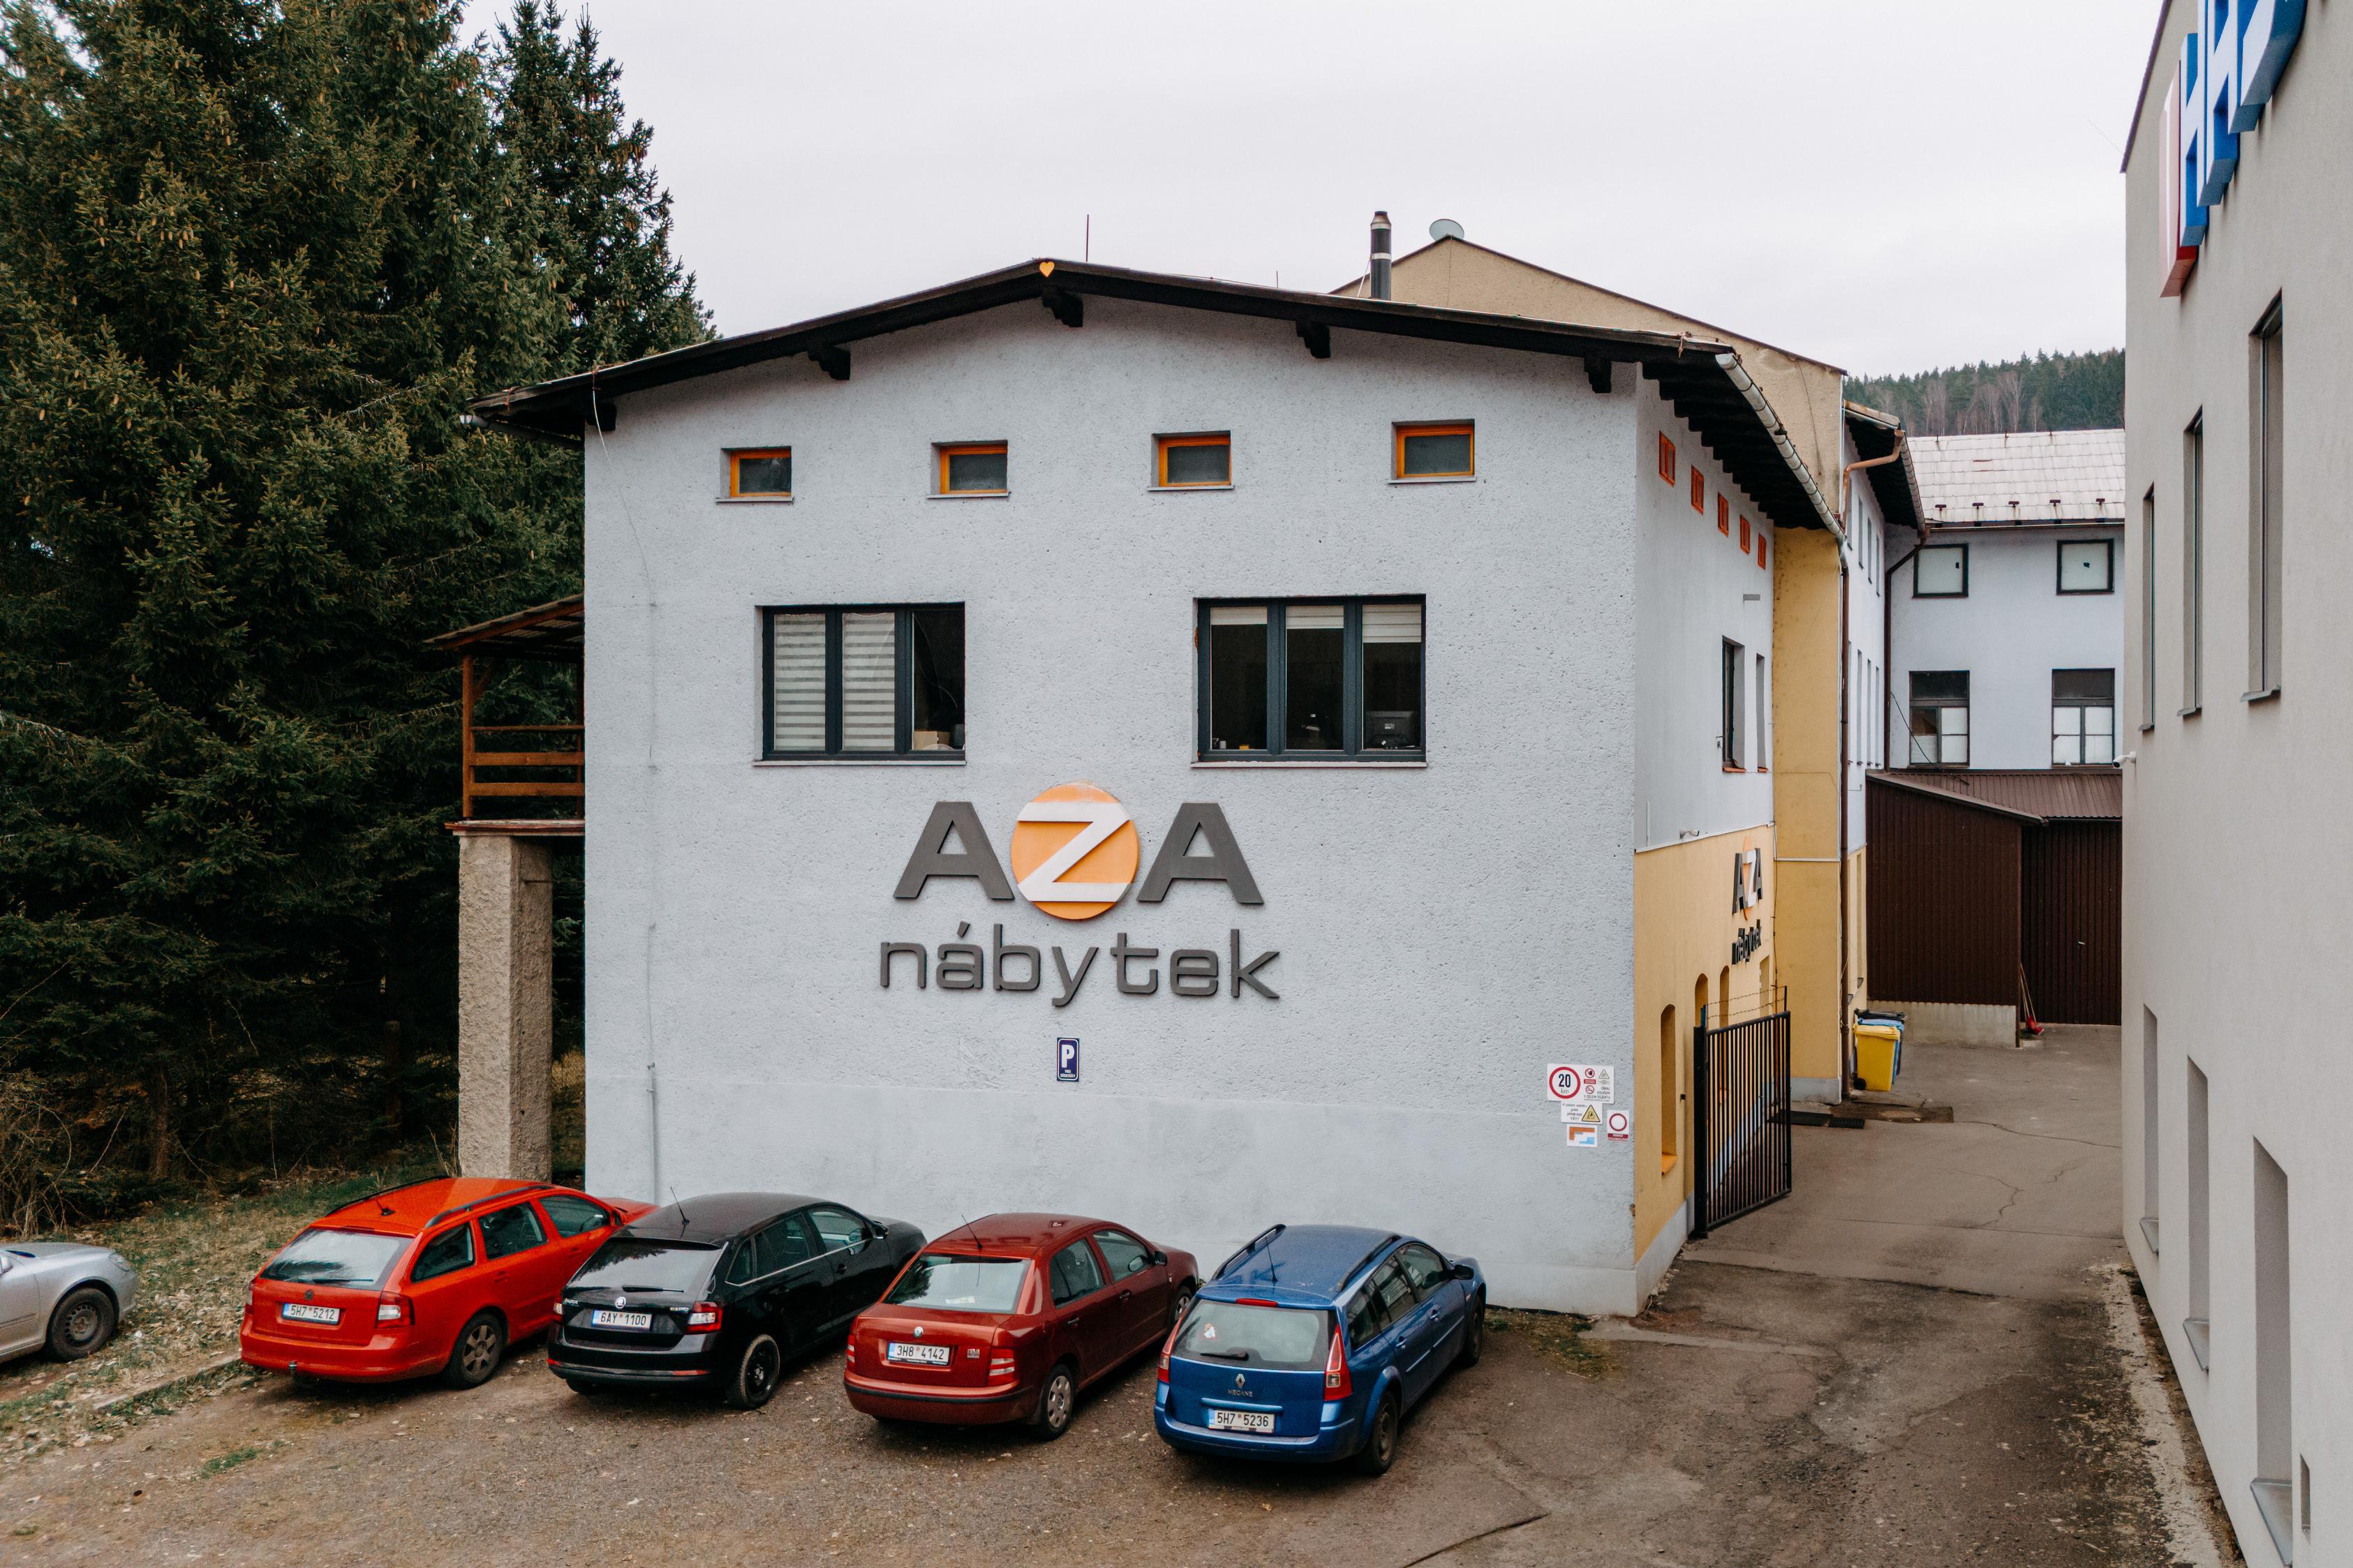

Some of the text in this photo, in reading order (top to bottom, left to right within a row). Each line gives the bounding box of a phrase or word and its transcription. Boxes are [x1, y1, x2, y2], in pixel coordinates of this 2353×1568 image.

[893, 800, 1264, 905] AZA
[1732, 847, 1763, 915] AZA
[880, 920, 1280, 1007] nábytek
[1061, 1044, 1075, 1068] P
[1558, 1073, 1571, 1088] 20
[291, 1305, 335, 1320] 5H7 5212
[601, 1312, 646, 1326] 6AY 1100
[897, 1345, 944, 1360] 3H8 4142
[1217, 1412, 1269, 1427] 5H7 5236
